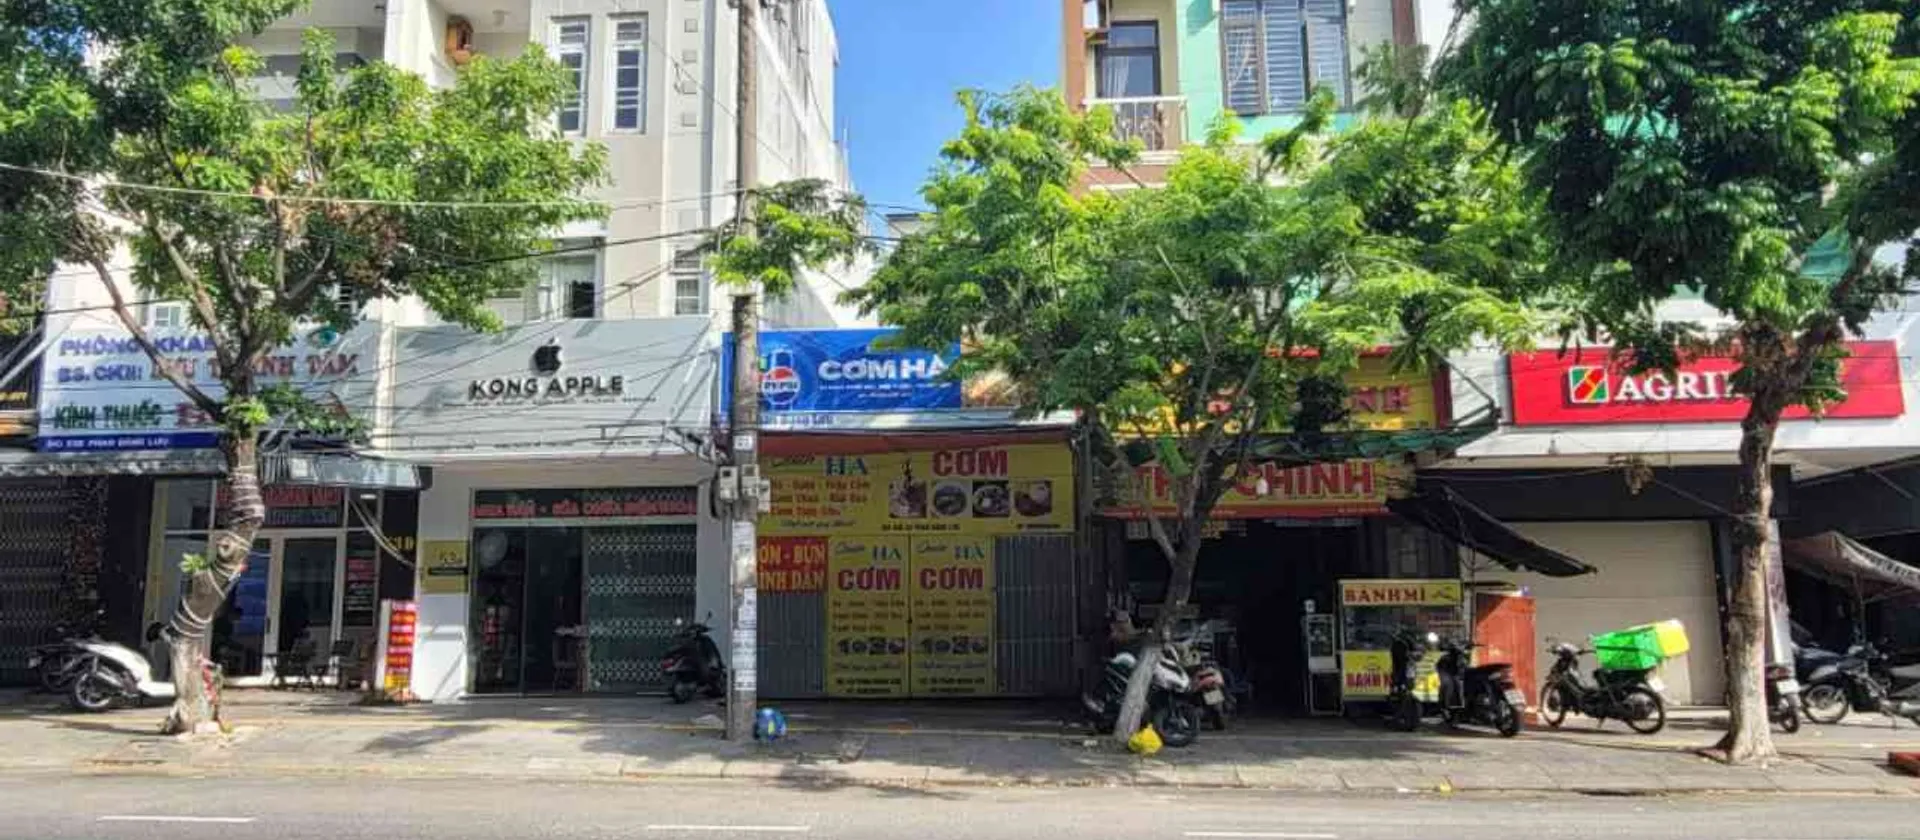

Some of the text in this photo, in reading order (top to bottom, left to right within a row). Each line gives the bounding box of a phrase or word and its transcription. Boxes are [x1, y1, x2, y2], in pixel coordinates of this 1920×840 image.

[818, 358, 896, 381] CƠM
[468, 376, 623, 399] KONG APPLE
[1614, 367, 1746, 401] AGRI
[759, 541, 781, 565] ƠM
[760, 566, 787, 590] ÌNH
[838, 566, 900, 591] CƠM
[920, 565, 984, 590] CƠM
